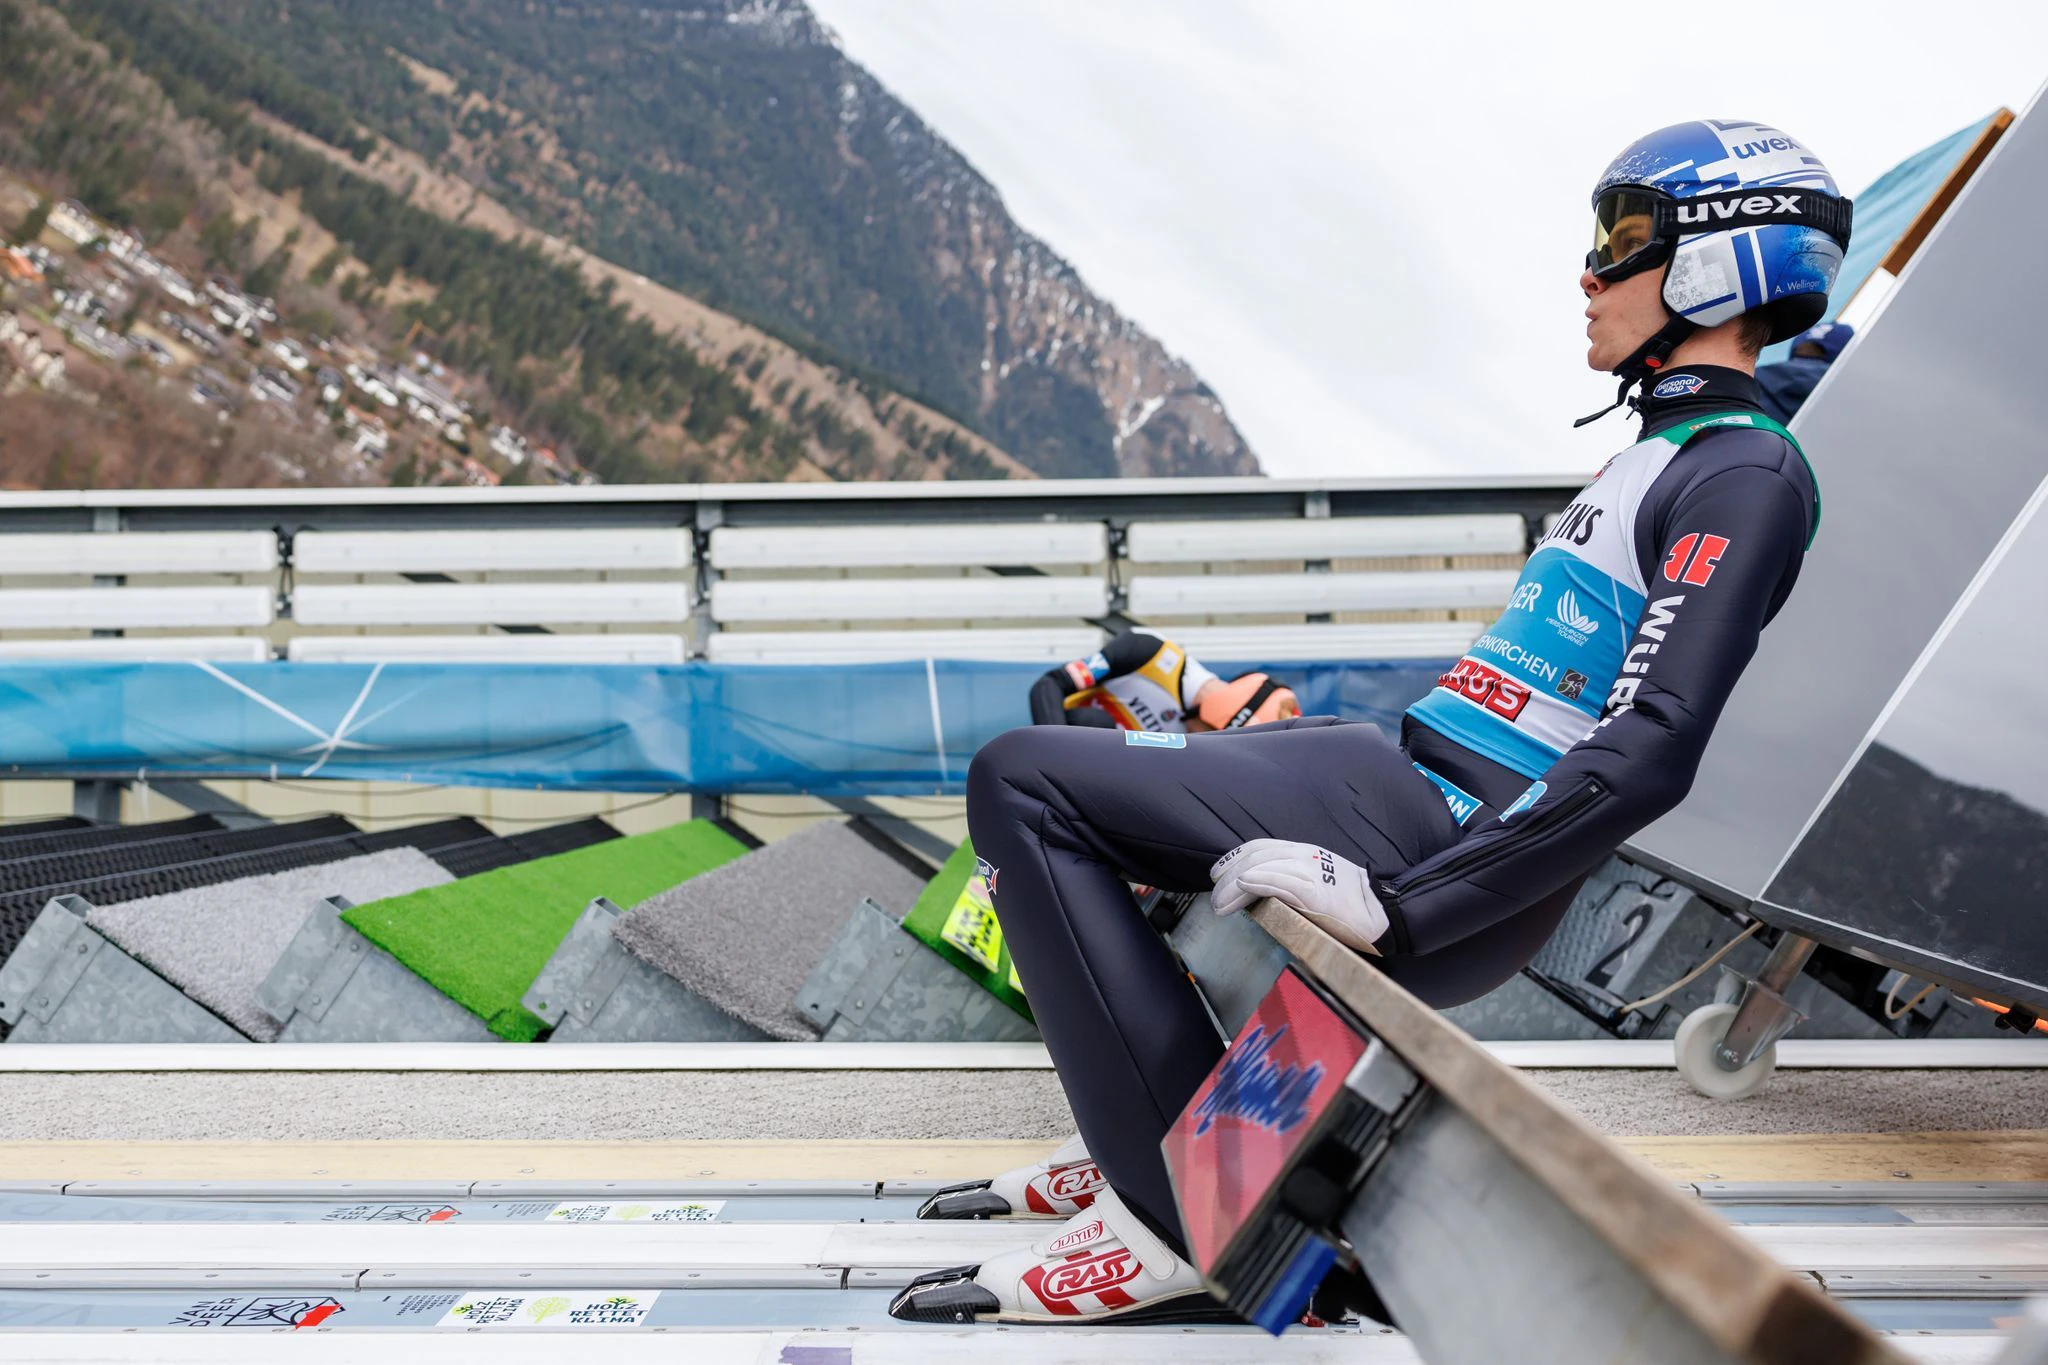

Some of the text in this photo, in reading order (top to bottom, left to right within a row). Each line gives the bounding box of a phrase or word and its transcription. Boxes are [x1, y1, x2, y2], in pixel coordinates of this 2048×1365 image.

[1731, 135, 1800, 160] uvex
[1677, 194, 1802, 224] uvex
[1787, 280, 1820, 291] Wellinger
[1657, 378, 1696, 393] personal
[1662, 385, 1684, 394] shop
[1219, 847, 1242, 867] SEIZ
[1319, 849, 1336, 886] SEIZ
[1057, 1253, 1131, 1292] RASS
[168, 1301, 216, 1324] VAN
[188, 1297, 243, 1327] DEER
